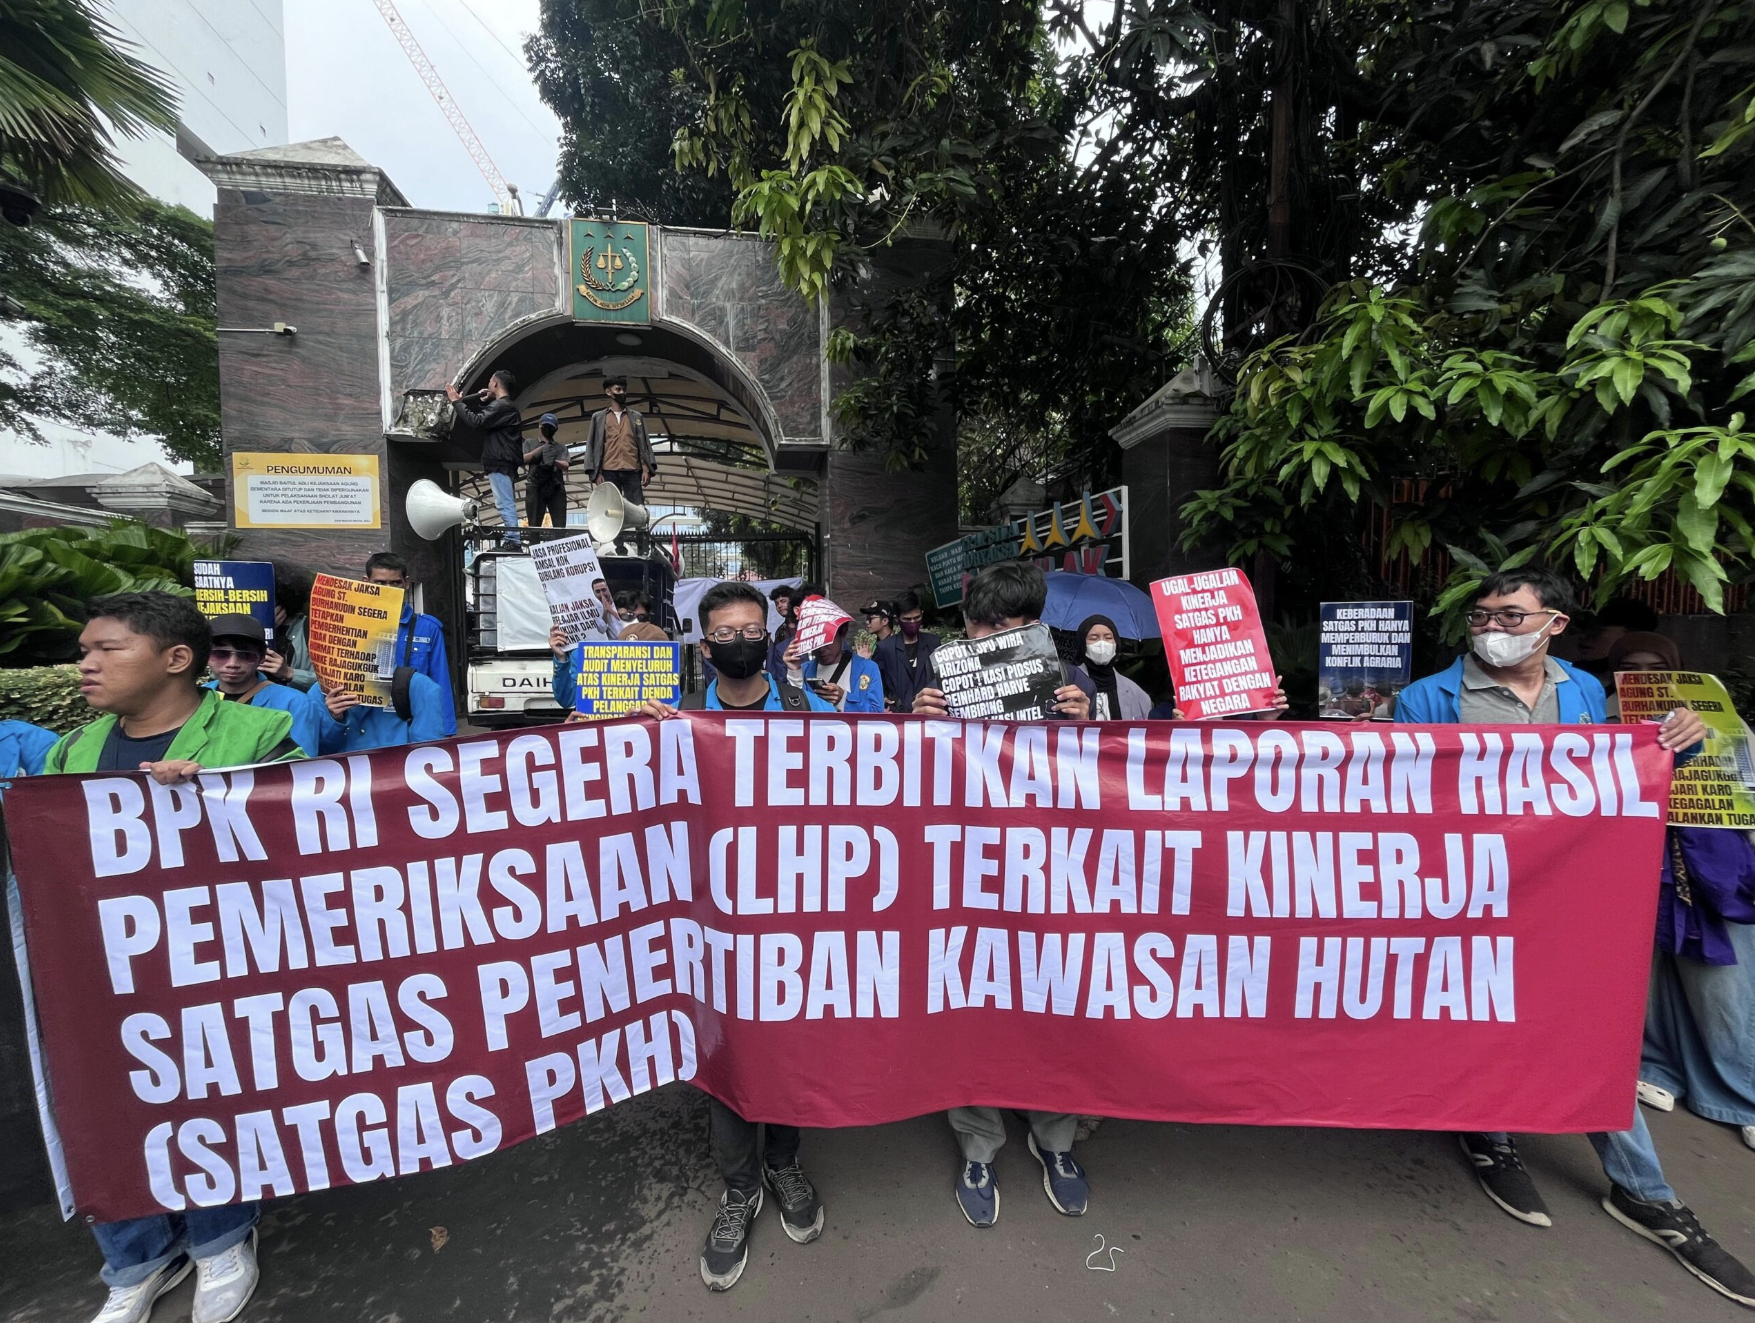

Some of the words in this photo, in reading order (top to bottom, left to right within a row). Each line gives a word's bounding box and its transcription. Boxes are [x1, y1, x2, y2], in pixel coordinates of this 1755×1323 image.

[266, 465, 352, 474] PENGUMUMAN
[532, 547, 547, 559] JASA
[547, 538, 591, 556] PROFESIONAL
[194, 563, 220, 575] SUDAH
[534, 558, 556, 571] AMSAL
[557, 555, 570, 566] KOK
[538, 568, 565, 582] DIBILANG
[565, 562, 596, 576] KORUPSI
[194, 576, 234, 588] SAATNYA
[317, 574, 353, 591] MENDESAK
[354, 583, 380, 596] JAKSA
[1161, 570, 1239, 595] UGAL-UGALAN
[313, 586, 336, 598] AGUNG
[337, 591, 348, 601] ST.
[1180, 590, 1228, 610] KINERJA
[312, 597, 356, 614] BURHANUDIN
[358, 607, 387, 620] SEGERA
[571, 598, 595, 611] JAKSA
[311, 608, 344, 623] TETAPKAN
[581, 608, 600, 620] ILMU
[1174, 610, 1216, 629] SATGAS
[1218, 605, 1242, 623] PKH
[1336, 608, 1394, 619] KEBERADAAN
[310, 619, 368, 639] PEMBERHENTIAN
[581, 620, 599, 631] DARI
[1323, 621, 1356, 631] SATGAS
[1358, 621, 1376, 631] PKH
[1379, 620, 1409, 631] HANYA
[310, 630, 327, 641] TIDAK
[328, 635, 357, 648] DENGAN
[566, 634, 581, 646] ANA
[1192, 625, 1230, 645] HANYA
[1321, 633, 1389, 643] MEMPERBURUK
[1391, 633, 1410, 643] DAN
[310, 641, 334, 653] HORMAT
[336, 647, 376, 662] TERHADAP
[584, 646, 651, 658] TRANSPARANSI
[654, 646, 673, 659] DAN
[800, 638, 813, 652] TGAS
[935, 644, 967, 663] COPOT
[975, 640, 996, 654] JPU
[997, 632, 1024, 650] WIRA
[1179, 639, 1254, 665] MENJADIKAN
[1332, 645, 1398, 655] MENIMBULKAN
[329, 657, 379, 673] RAJAGUKGUK
[583, 660, 608, 672] AUDIT
[611, 660, 673, 672] MENYELURUH
[938, 657, 981, 678] ARIZONA
[1184, 656, 1258, 682] KETEGANGAN
[1326, 657, 1361, 667] KONFLIK
[1363, 657, 1401, 668] AGRARIA
[343, 672, 365, 682] KARO
[577, 673, 599, 685] ATAS
[602, 673, 640, 686] KINERJA
[643, 673, 679, 686] SATGAS
[942, 674, 974, 693] COPOT
[983, 668, 1005, 684] KASI
[1007, 659, 1044, 678] PIDSUS
[1622, 674, 1674, 685] MENDESAK
[1676, 674, 1704, 685] JAKSA
[582, 687, 600, 699] PKH
[602, 687, 639, 699] TERKAIT
[642, 687, 673, 699] DENDA
[945, 685, 995, 708] REINHARD
[996, 678, 1030, 697] HARVE
[1179, 681, 1220, 701] RAKYAT
[1222, 672, 1271, 693] DENGAN
[1620, 687, 1654, 698] AGUNG
[1658, 687, 1674, 698] ST.
[357, 694, 383, 705] TUGAS
[1201, 693, 1251, 715] NEGARA
[1622, 701, 1688, 712] BURHANUDIN
[1692, 701, 1724, 712] SEGERA
[948, 699, 1004, 719] SEMBIRING
[1016, 706, 1043, 720] INTEL
[1669, 784, 1698, 795] JARI
[1702, 784, 1732, 796] KARO
[81, 768, 268, 878] BPK
[291, 755, 377, 856] RI
[404, 718, 702, 839] SEGERA
[726, 718, 1101, 810] TERBITKAN
[1126, 728, 1436, 815] LAPORAN
[1459, 732, 1659, 819] HASIL
[1667, 812, 1723, 825] ALANKAN
[1727, 813, 1755, 826] TUGA
[97, 821, 692, 994] PEMERIKSAAN
[708, 824, 899, 916] (LHP)
[925, 824, 1202, 916] TERKAIT
[1227, 831, 1509, 920] KINERJA
[120, 974, 453, 1104] SATGAS
[477, 918, 899, 1051] PENERTIBAN
[927, 926, 1271, 1020] KAWASAN
[1294, 936, 1516, 1022] HUTAN
[144, 1075, 502, 1211] (SATGAS
[525, 1009, 698, 1135] PKH)
